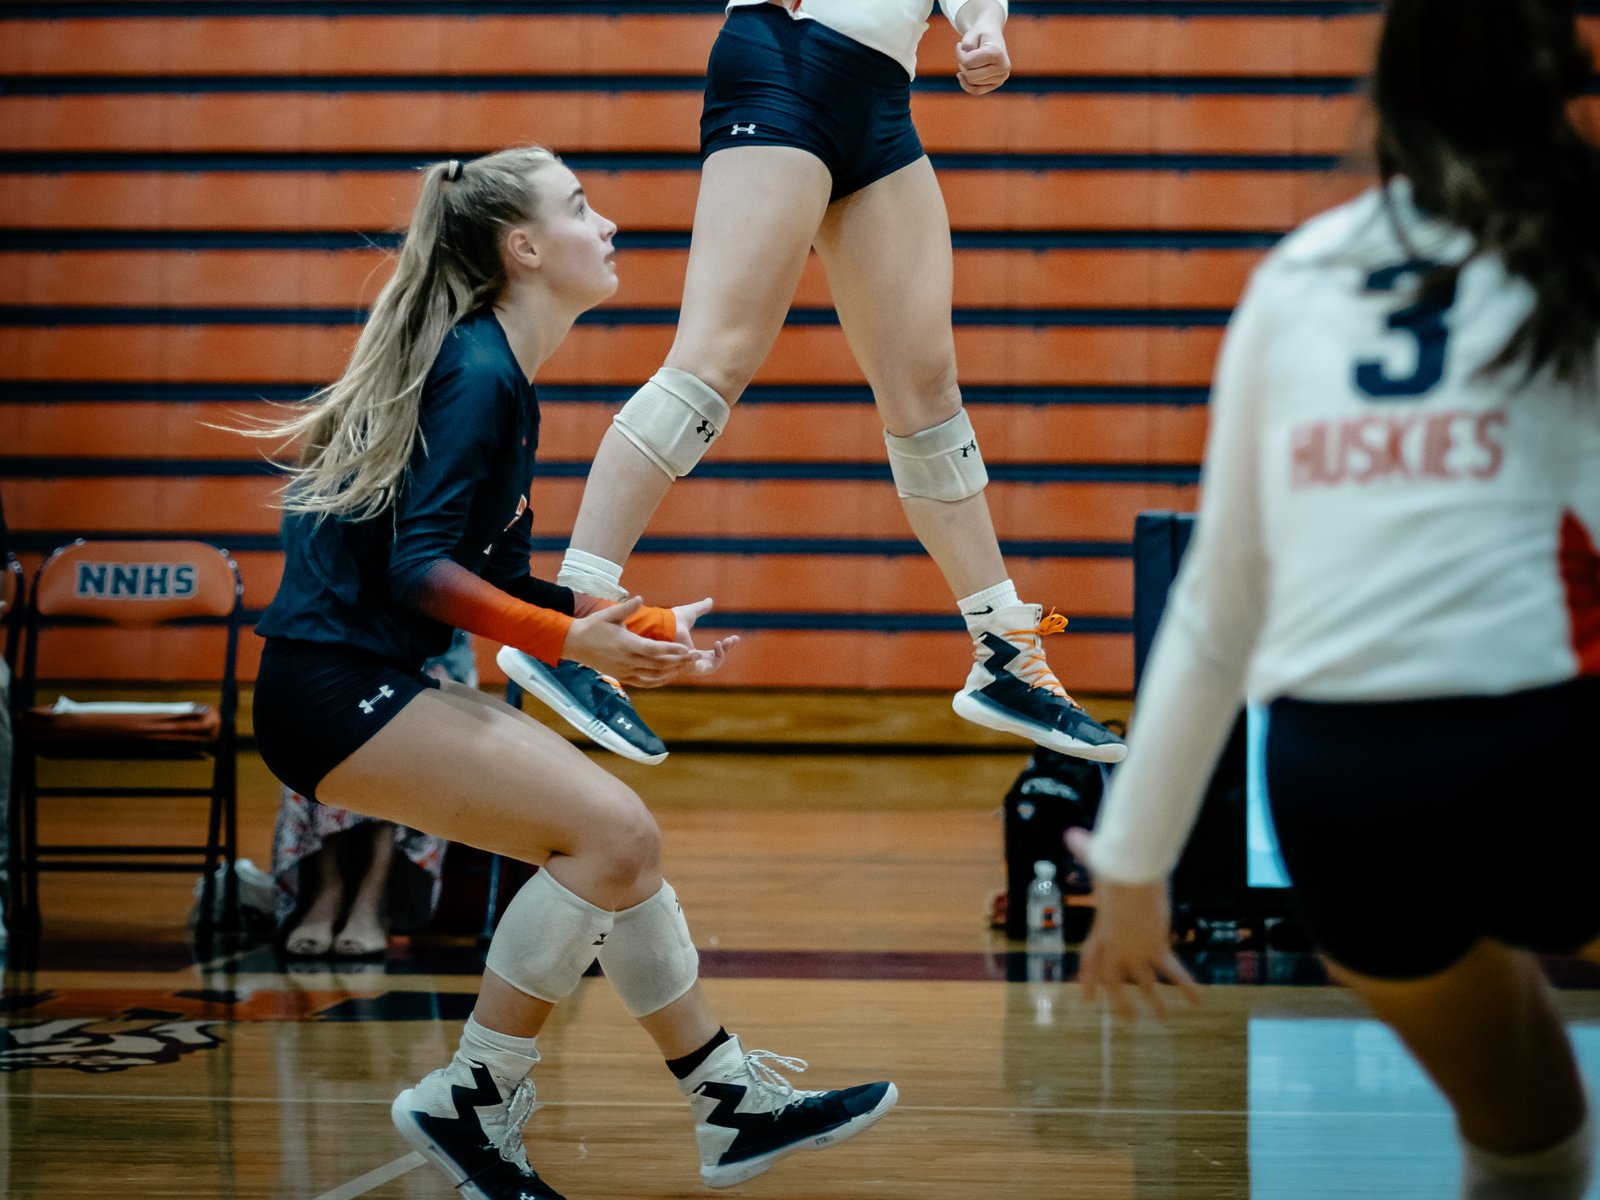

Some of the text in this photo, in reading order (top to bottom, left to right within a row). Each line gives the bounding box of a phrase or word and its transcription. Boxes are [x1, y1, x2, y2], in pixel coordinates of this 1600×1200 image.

[1354, 262, 1458, 397] 3
[1290, 411, 1508, 490] HUSKIES
[77, 564, 198, 598] NNHS
